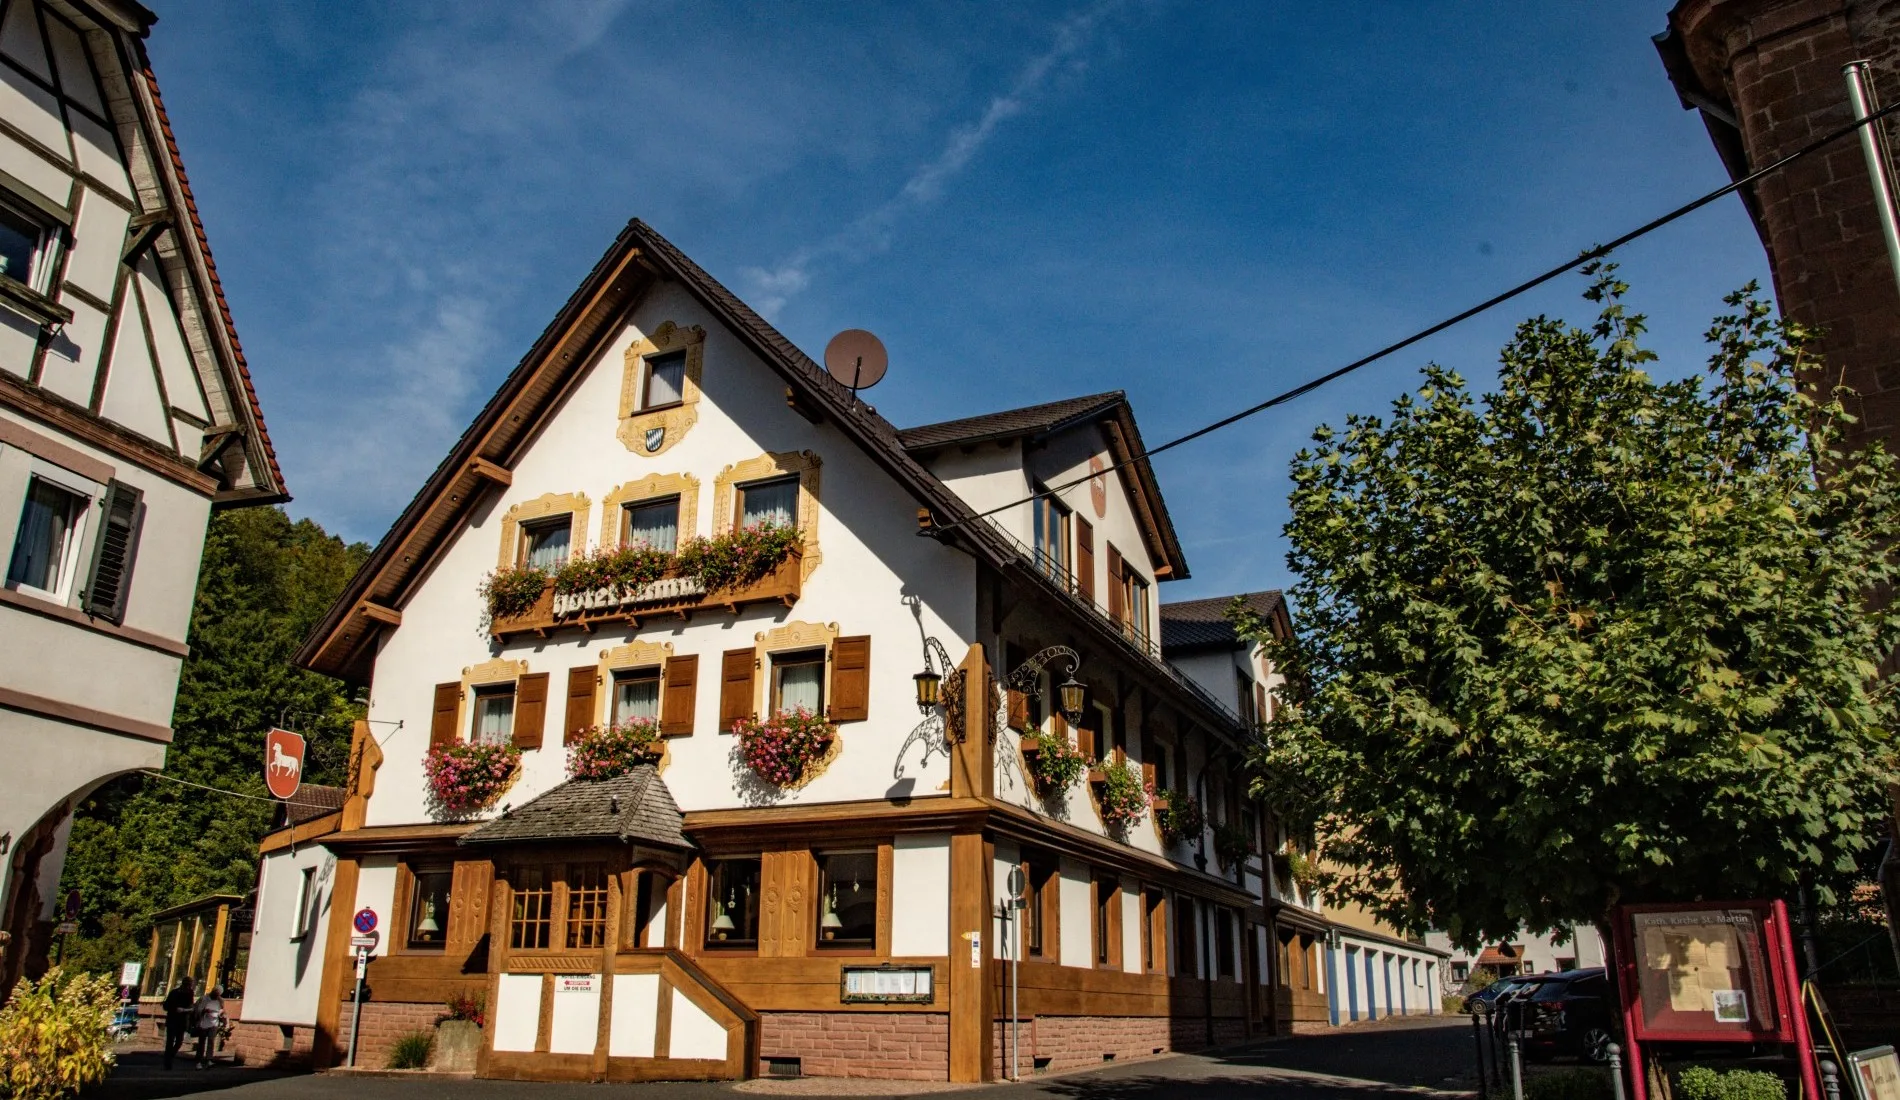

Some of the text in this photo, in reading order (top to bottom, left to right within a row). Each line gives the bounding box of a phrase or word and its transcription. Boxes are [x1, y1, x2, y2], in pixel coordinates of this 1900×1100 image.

[1670, 916, 1698, 925] Kirche
[1702, 916, 1713, 924] St.
[1717, 914, 1748, 924] Martin
